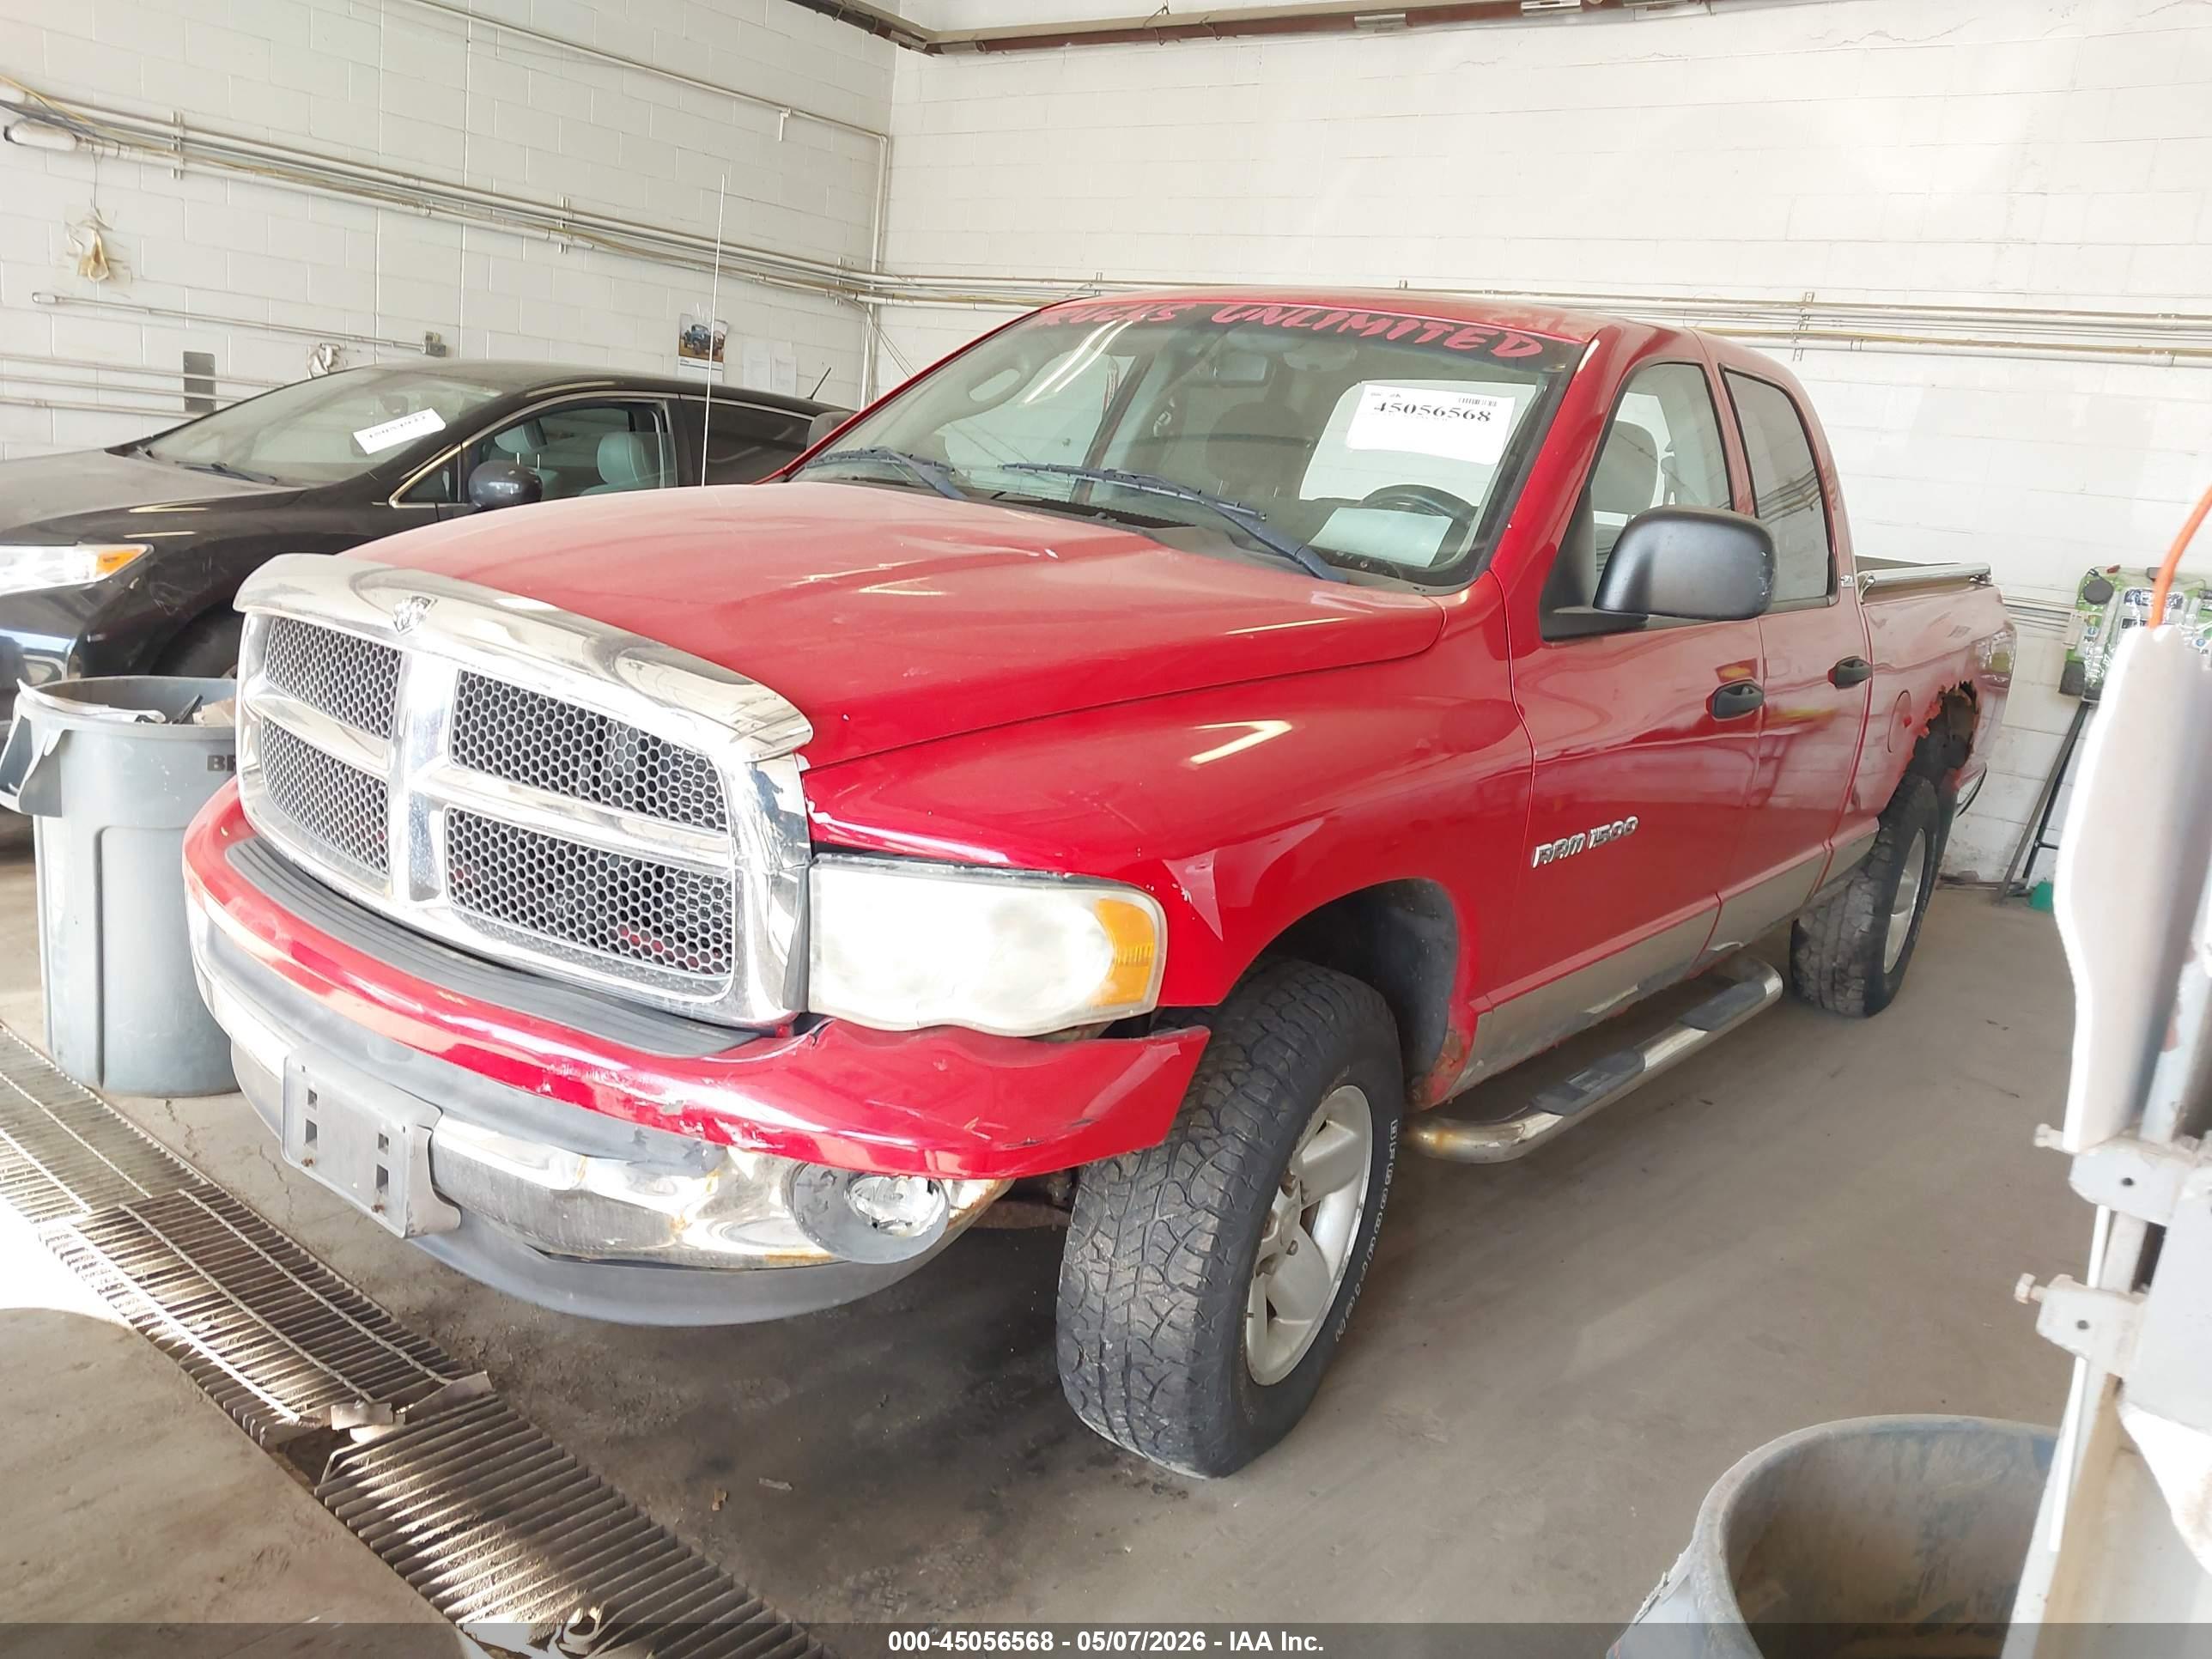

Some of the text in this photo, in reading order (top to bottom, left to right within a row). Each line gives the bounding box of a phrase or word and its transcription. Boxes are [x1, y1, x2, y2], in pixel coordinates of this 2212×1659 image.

[1212, 304, 1543, 357] UNLIMITED
[1374, 402, 1492, 422] 45056568
[1587, 816, 1638, 849] 1500
